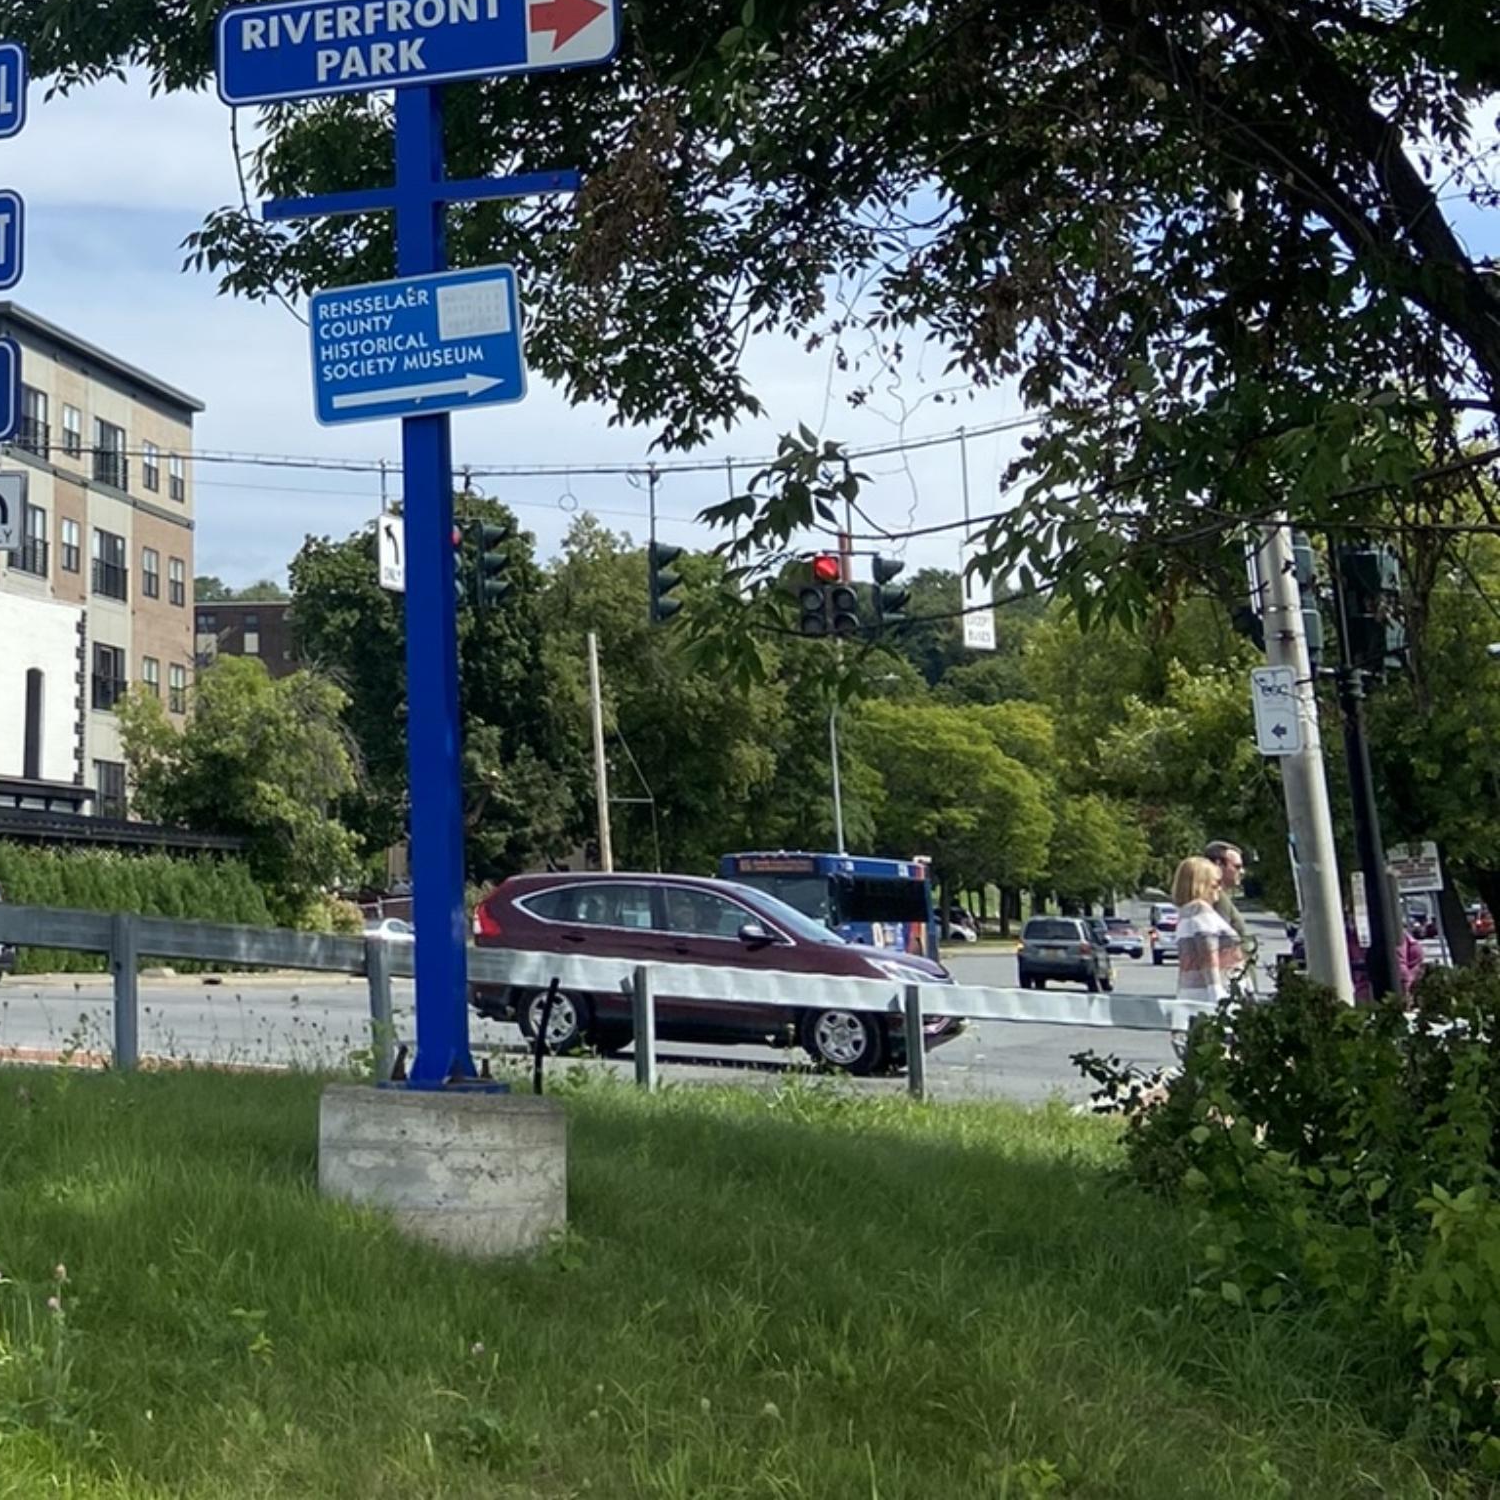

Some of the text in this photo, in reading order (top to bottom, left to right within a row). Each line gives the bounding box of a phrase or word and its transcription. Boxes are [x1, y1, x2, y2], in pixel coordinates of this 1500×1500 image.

[317, 38, 427, 82] PARK
[318, 288, 429, 320] RENSSELAER
[320, 314, 393, 340] COUNTY
[321, 332, 429, 362] HISTORICAL
[323, 345, 484, 382] SOCIETY MUSEUM
